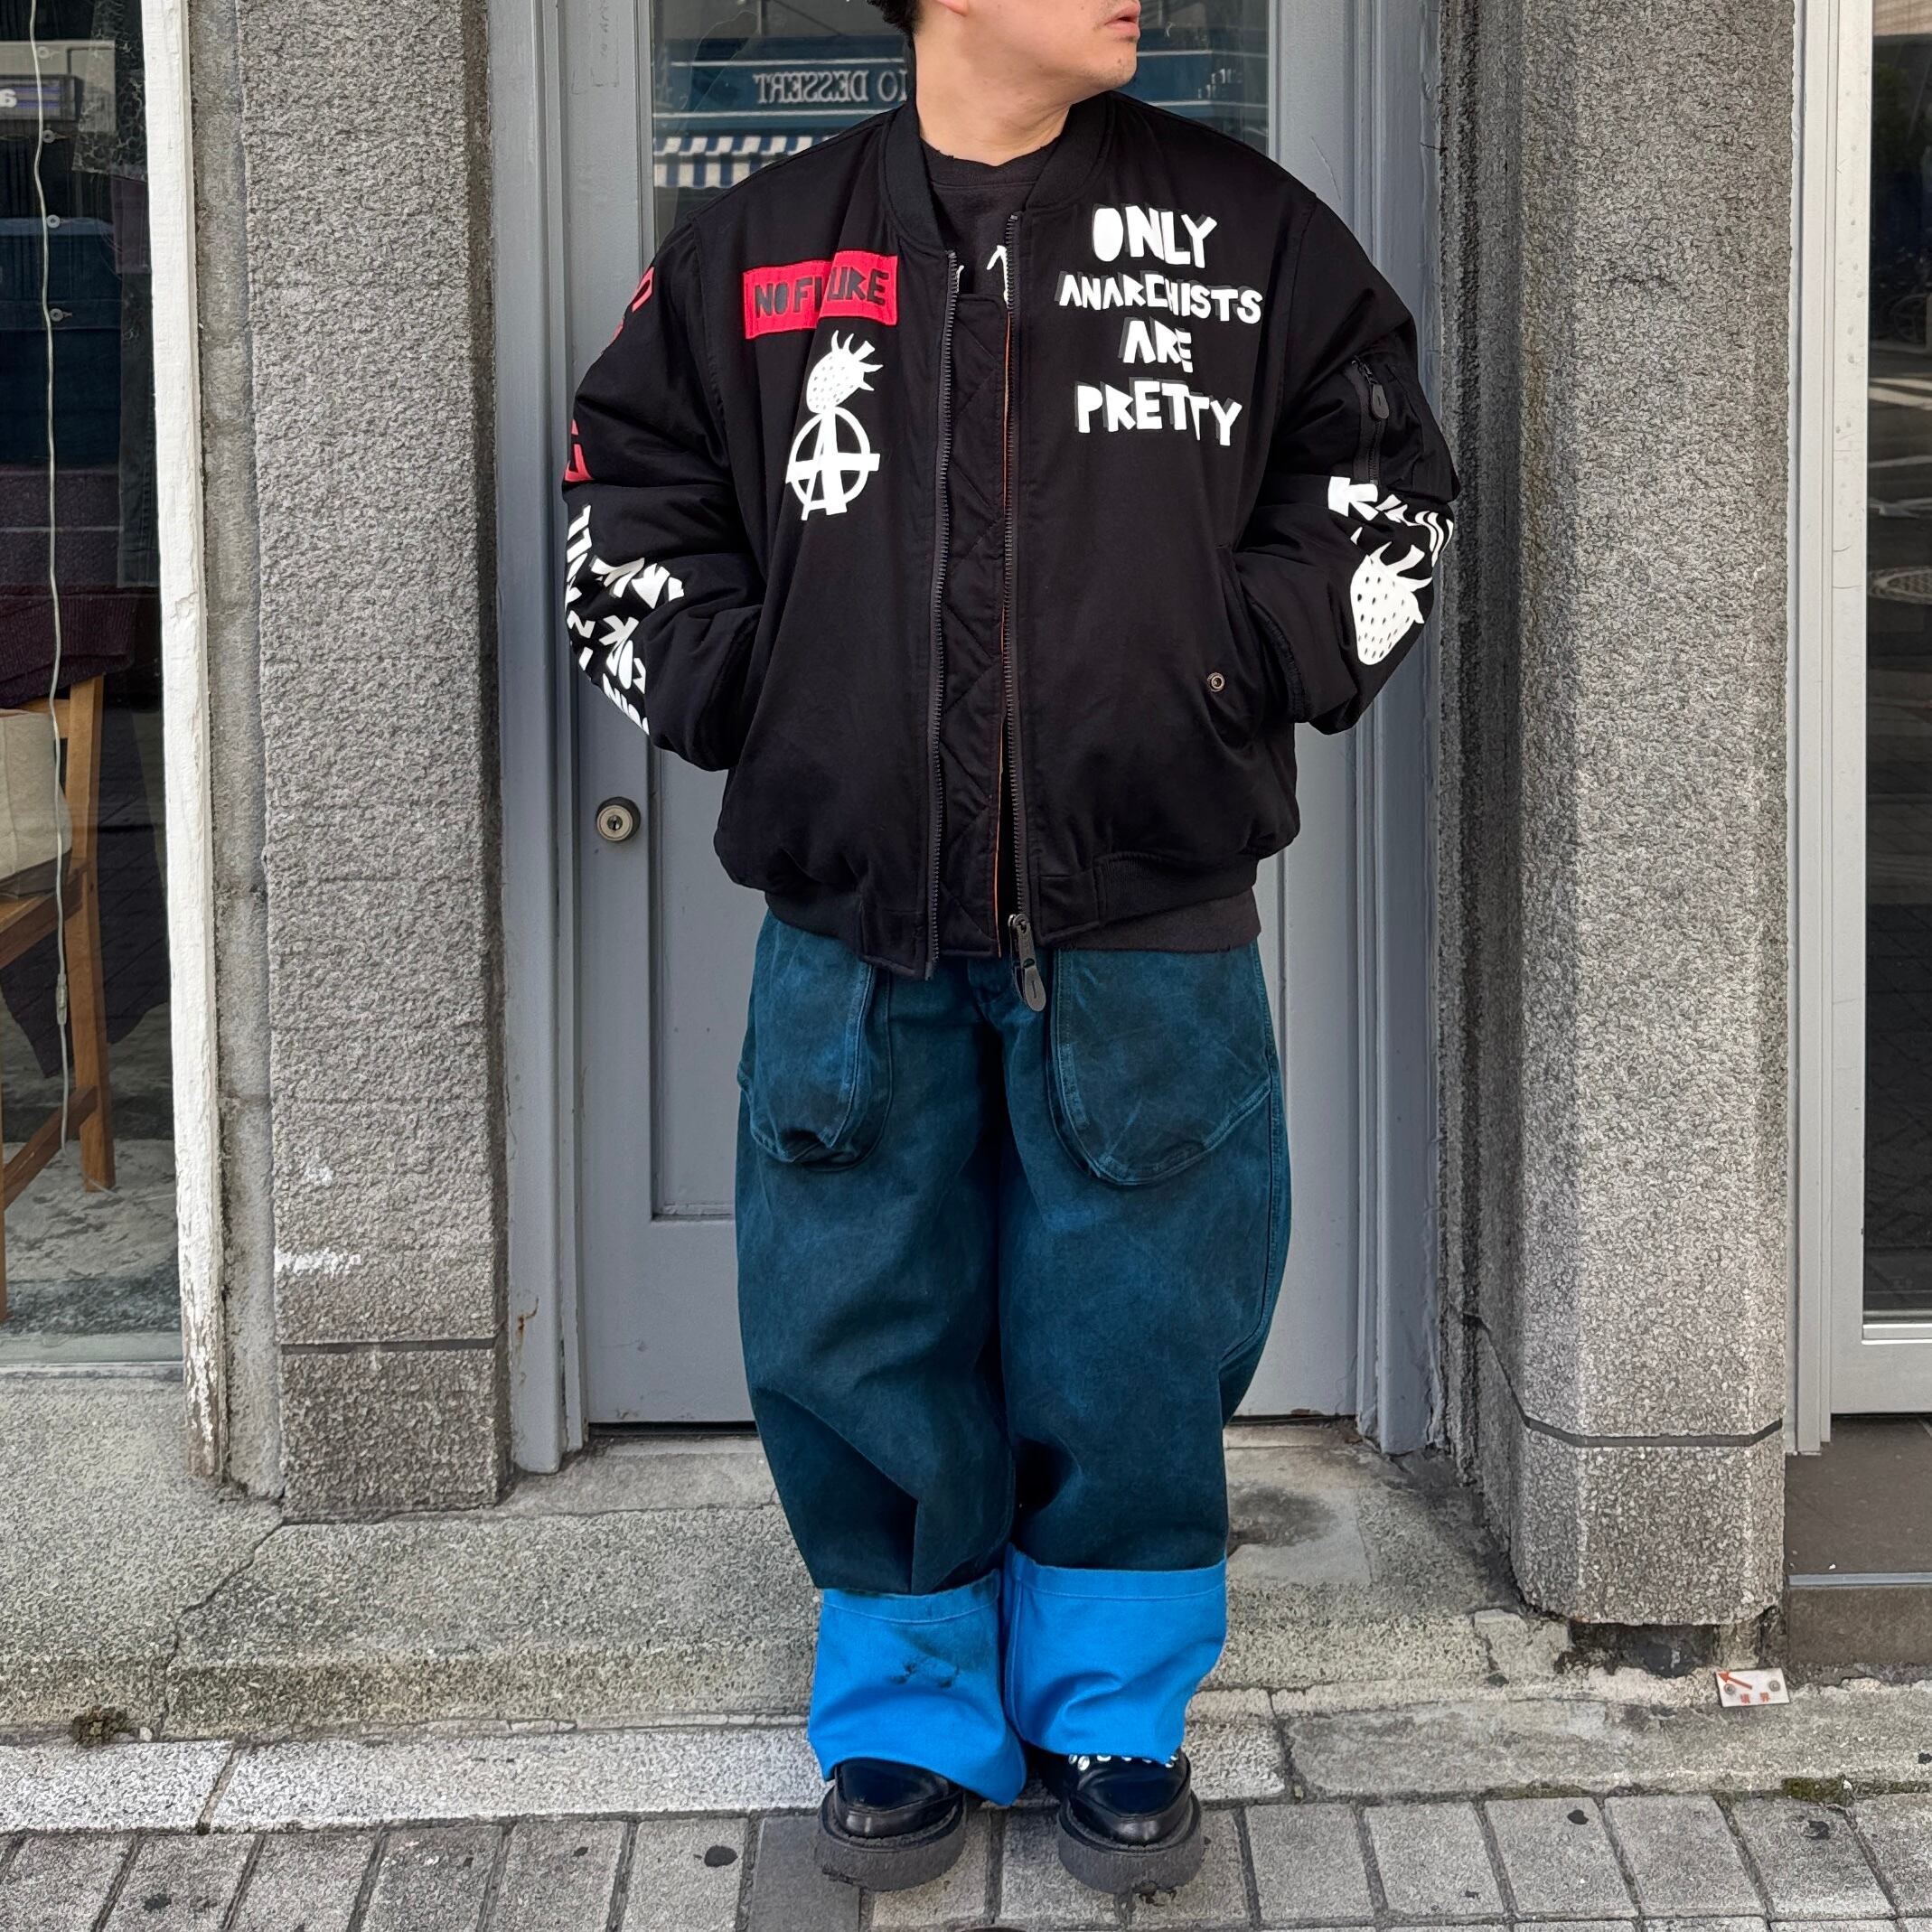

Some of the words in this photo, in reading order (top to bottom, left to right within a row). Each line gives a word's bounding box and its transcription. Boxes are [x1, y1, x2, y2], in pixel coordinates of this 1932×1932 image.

[1092, 204, 1218, 269] ONLY
[754, 281, 788, 318] NO
[1056, 273, 1263, 324] ANARCHISTS
[1121, 319, 1194, 373] ARE
[1076, 380, 1243, 446] PRETTY
